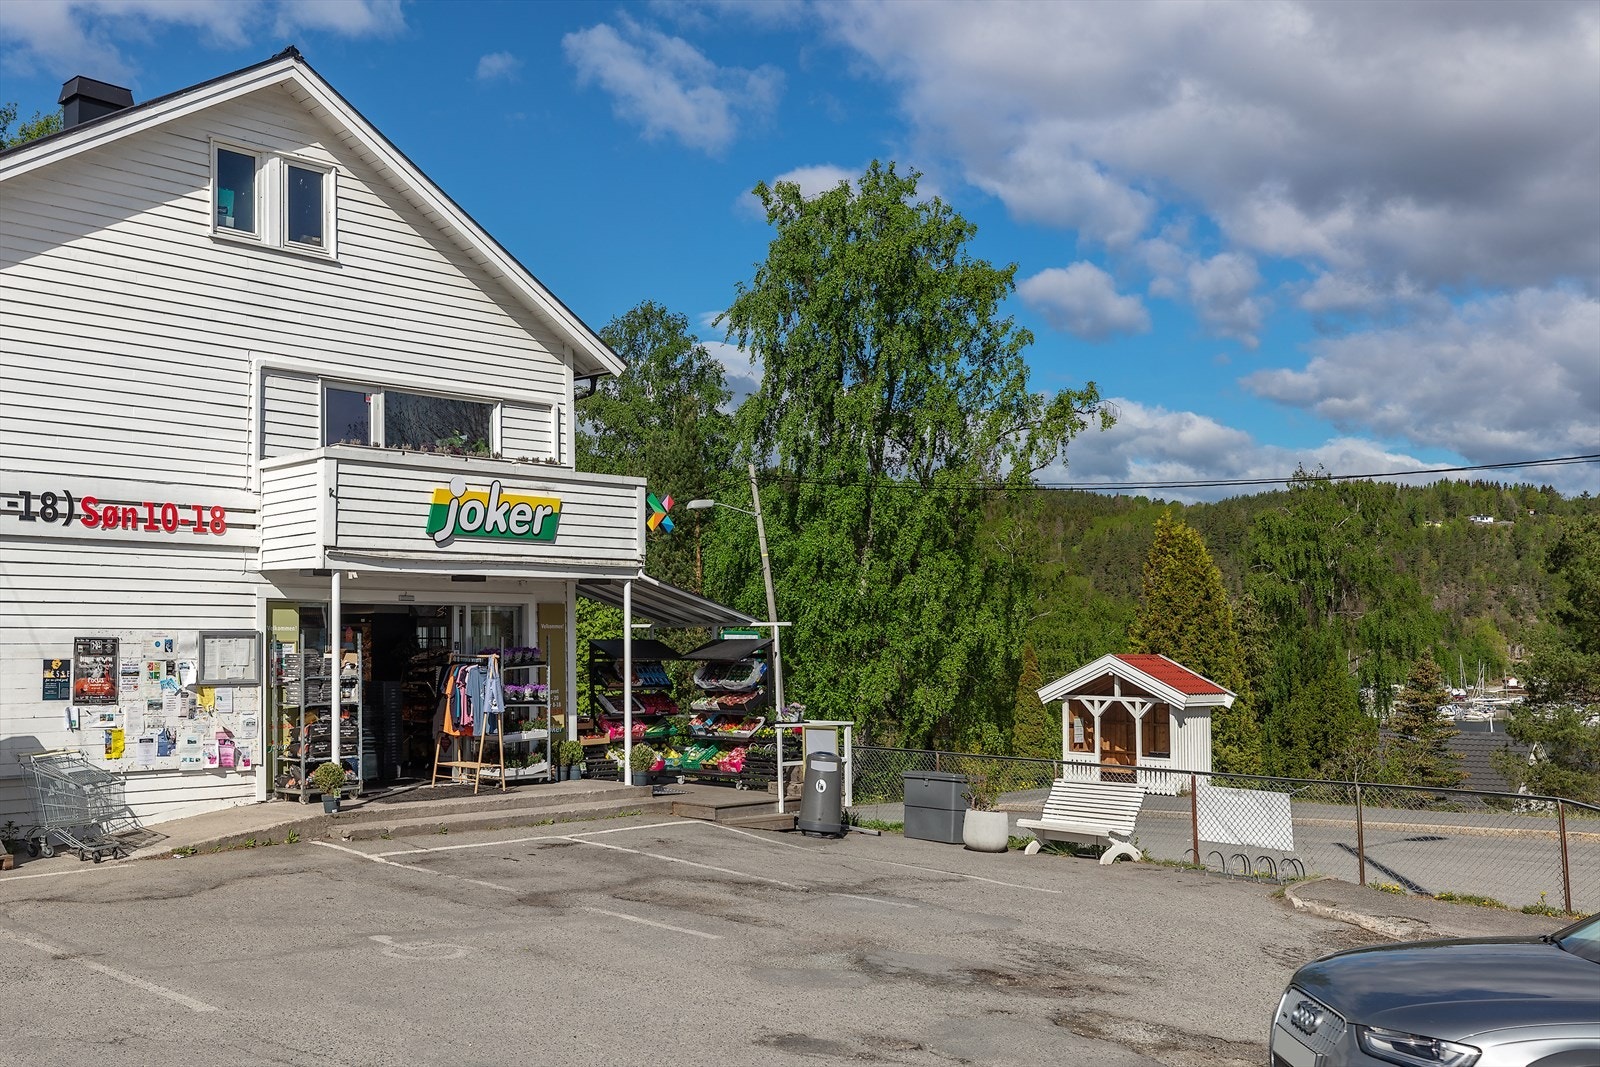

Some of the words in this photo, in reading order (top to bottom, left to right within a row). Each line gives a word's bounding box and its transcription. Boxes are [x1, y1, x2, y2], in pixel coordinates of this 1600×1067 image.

[80, 496, 138, 530] Søn
[142, 501, 226, 536] 10-18
[433, 476, 554, 543] joker
